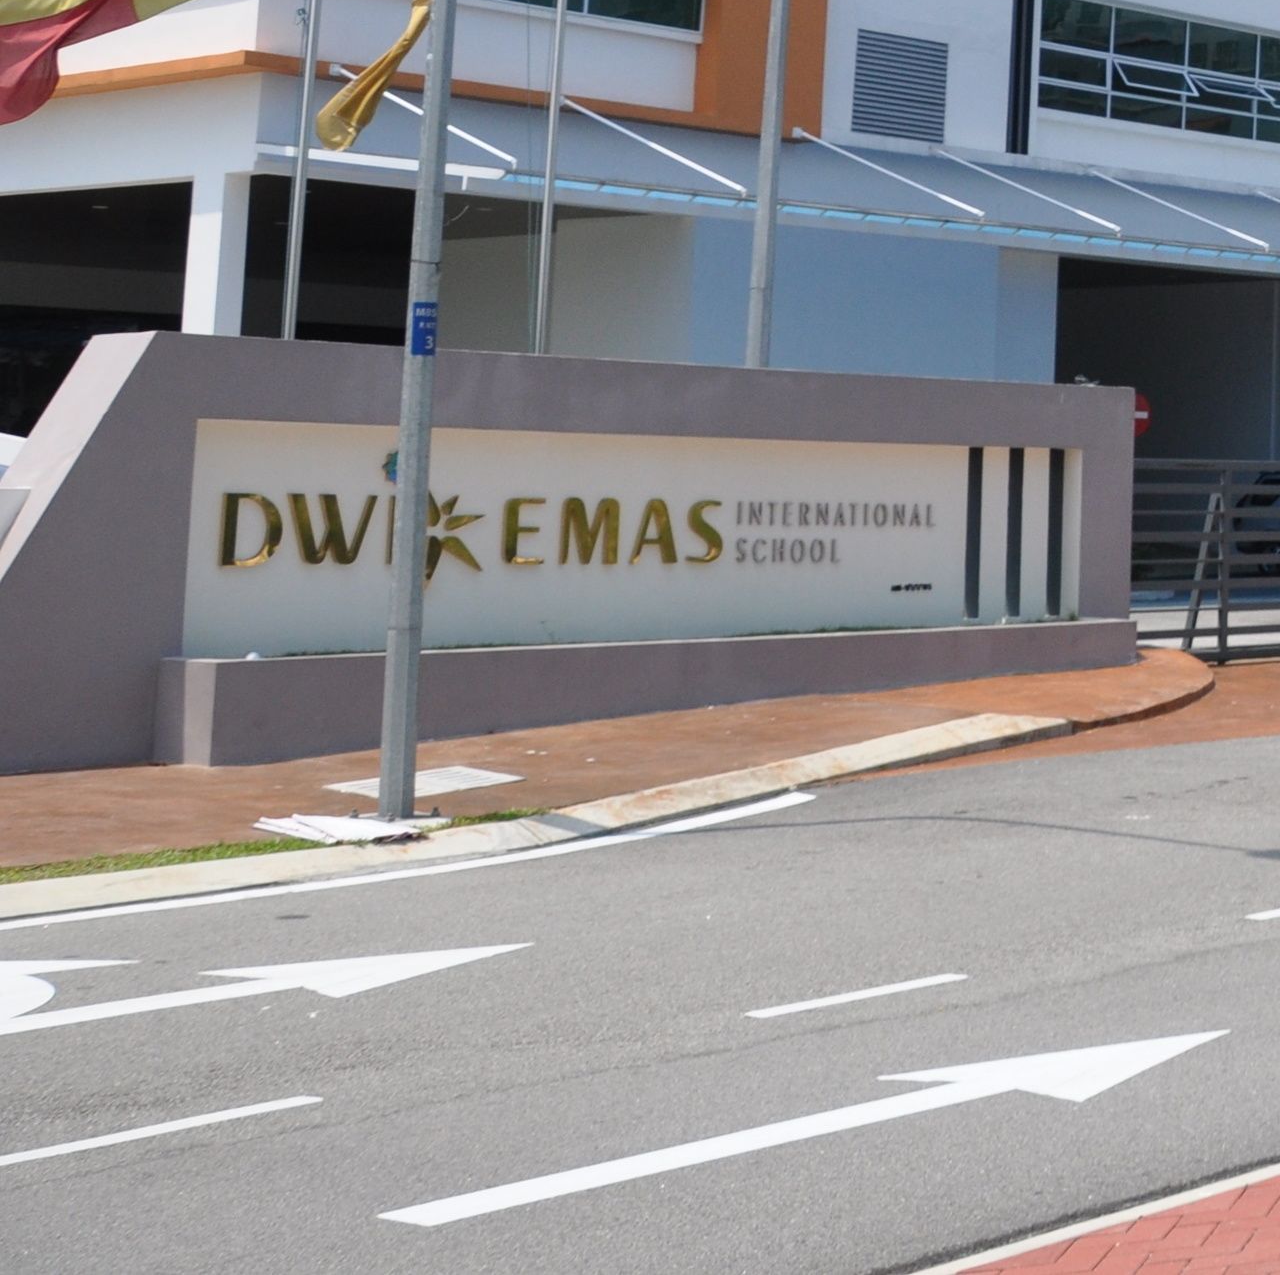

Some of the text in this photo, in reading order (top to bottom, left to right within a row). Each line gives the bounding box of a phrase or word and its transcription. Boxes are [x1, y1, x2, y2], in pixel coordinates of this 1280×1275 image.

[735, 500, 935, 529] INTERNATIONAL
[502, 496, 724, 566] EMAS
[735, 537, 841, 565] SCHOOL
